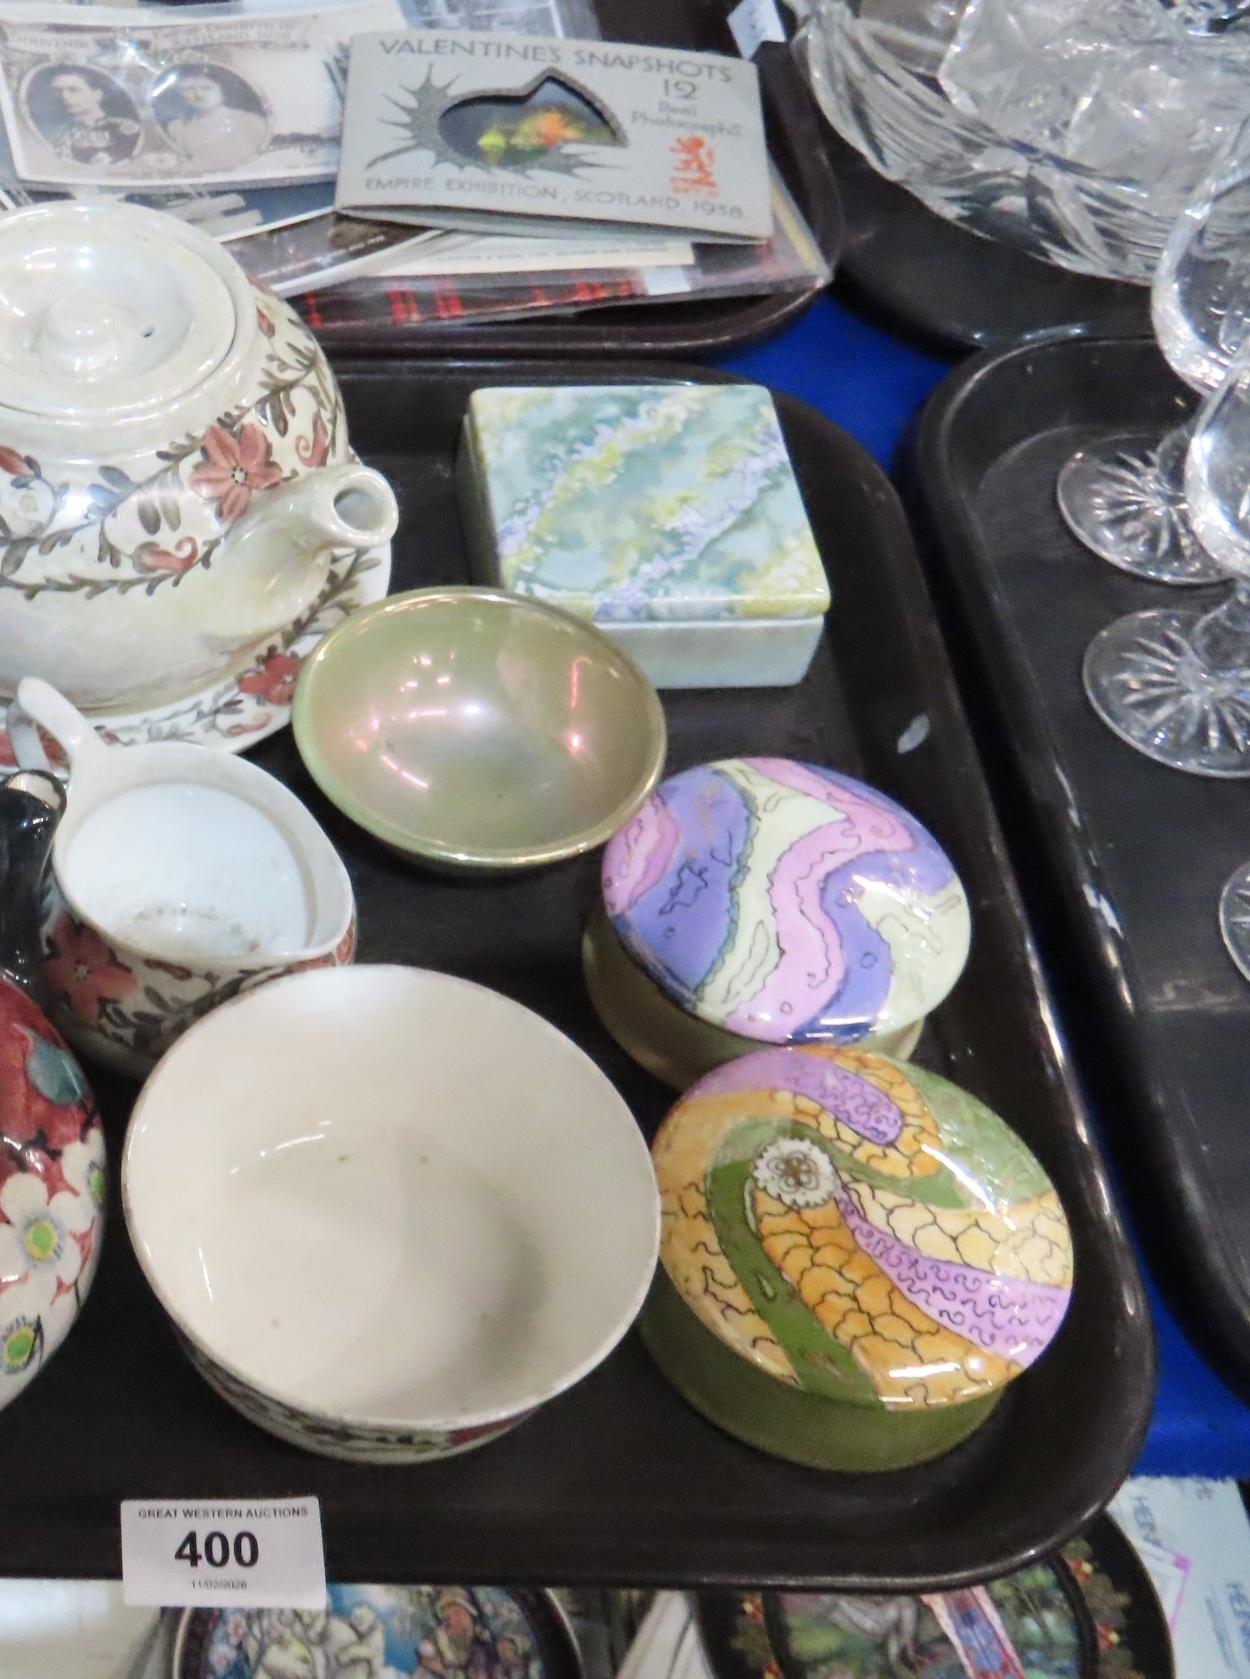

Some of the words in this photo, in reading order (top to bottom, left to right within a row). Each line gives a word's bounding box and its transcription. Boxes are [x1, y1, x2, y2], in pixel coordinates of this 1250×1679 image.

[575, 50, 733, 82] SNAPSHOTS
[663, 78, 697, 100] 12
[658, 101, 697, 116] Real
[631, 110, 742, 137] Photographs
[365, 177, 434, 191] EMPIRE
[138, 1507, 178, 1519] GREAT
[182, 1507, 242, 1519] WESTERN
[246, 1506, 308, 1519] AUCTIONS
[174, 1530, 259, 1568] 400
